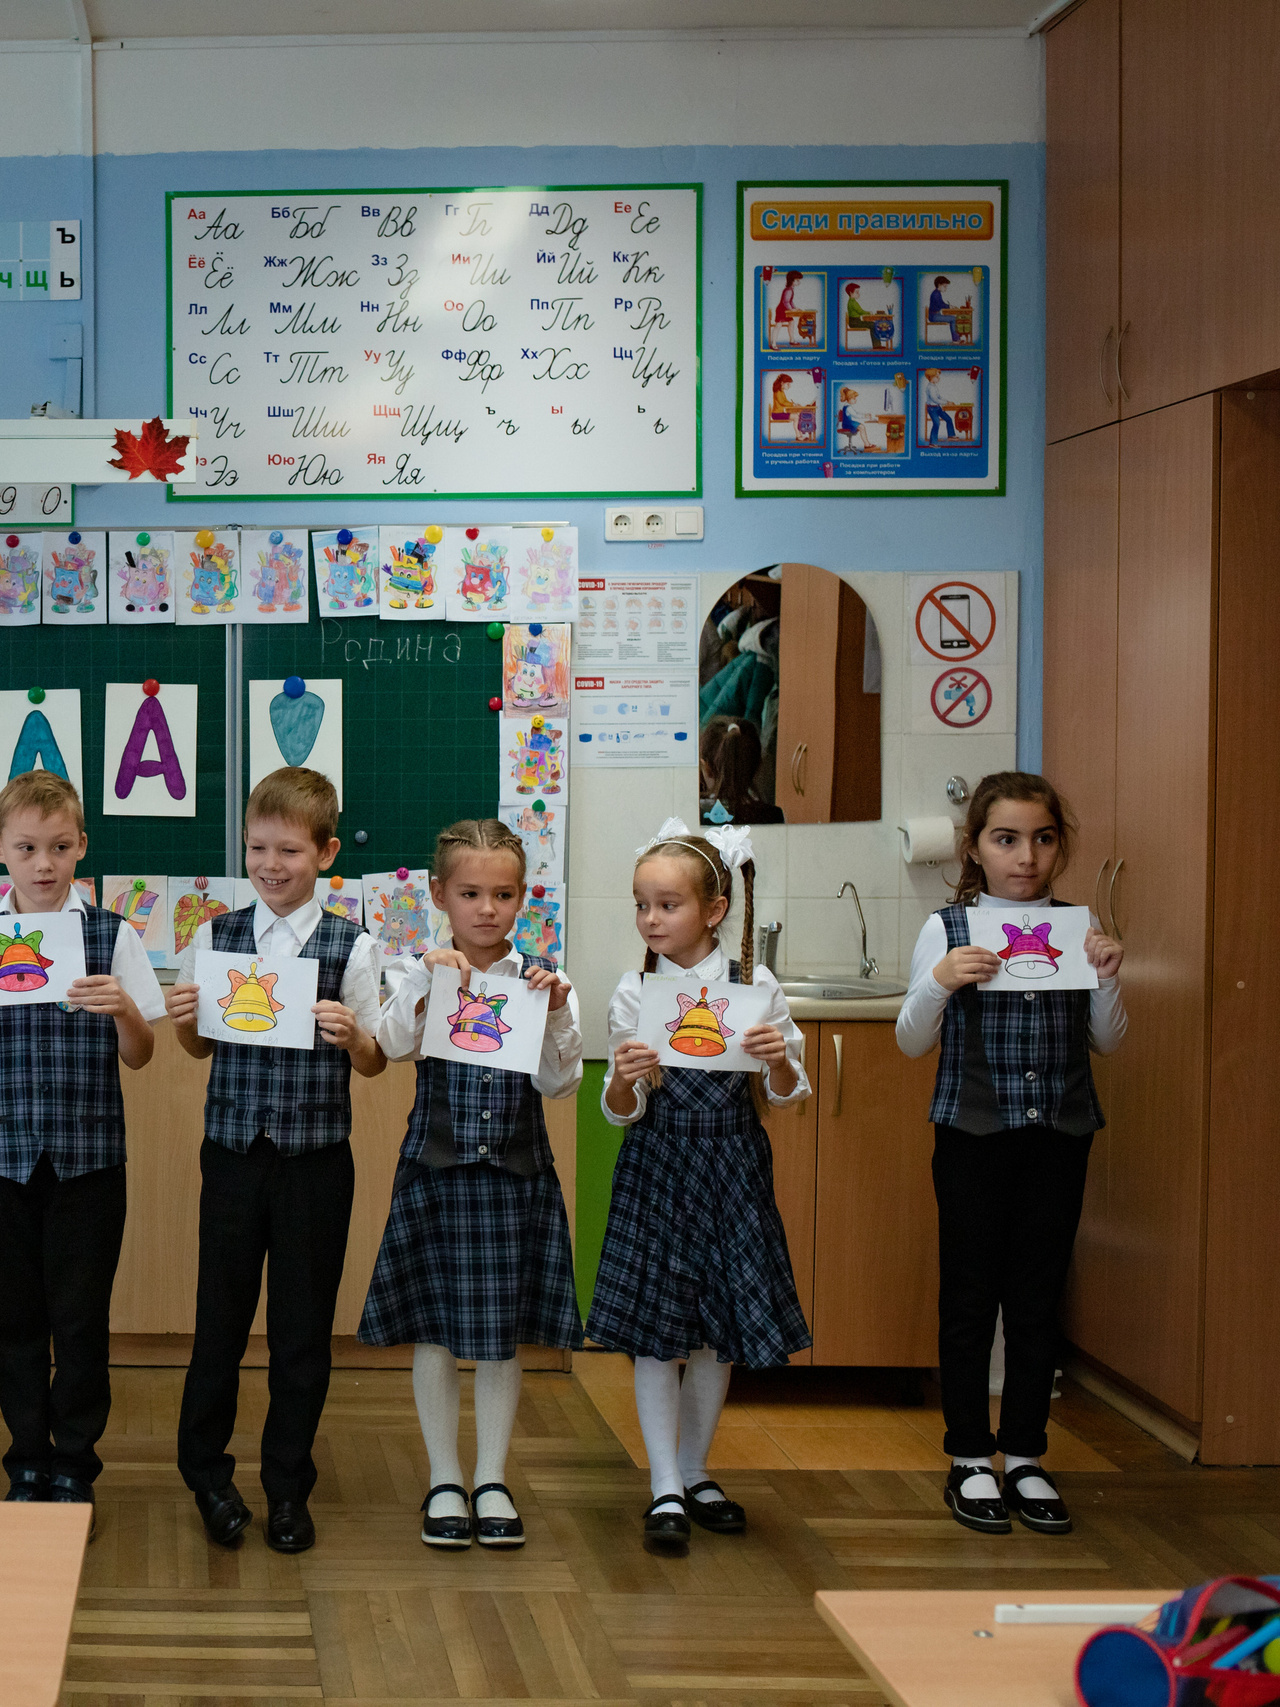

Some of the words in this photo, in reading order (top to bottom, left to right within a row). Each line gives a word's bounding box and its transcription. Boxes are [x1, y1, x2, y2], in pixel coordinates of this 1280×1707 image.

[187, 208, 206, 220] Аа
[271, 207, 290, 219] Бб
[361, 206, 381, 217] Вв
[445, 204, 460, 216] Гг
[529, 203, 550, 217] Дд
[614, 202, 632, 213] Ее
[760, 208, 829, 233] Сиди
[838, 212, 984, 235] правильно
[56, 227, 76, 244] ъ
[188, 255, 206, 269] Ёё
[263, 256, 288, 268] Жж
[371, 254, 388, 266] Зз
[451, 253, 470, 265] Ии
[536, 250, 556, 264] Йй
[613, 251, 629, 263] Кк
[26, 270, 48, 291] щ
[60, 271, 75, 288] ь
[188, 303, 208, 315] Лл
[269, 302, 292, 313] Мм
[360, 301, 380, 312] Нн
[443, 300, 464, 311] Оо
[530, 298, 549, 310] Пп
[614, 298, 633, 312] Рр
[188, 353, 207, 364] Сс
[263, 352, 280, 363] Тт
[364, 350, 381, 364] Уу
[441, 349, 467, 363] Фф
[521, 348, 538, 359] Хх
[613, 347, 633, 361] Цц
[767, 354, 794, 362] Посадка
[189, 407, 207, 418] Чч
[267, 406, 294, 417] Шш
[373, 405, 401, 418] Щщ
[268, 454, 295, 466] Юю
[367, 453, 386, 465] Яя
[761, 451, 788, 459] Посадка
[839, 461, 865, 469] Посадка
[41, 486, 62, 515] 0
[578, 581, 604, 589] COVID-19
[576, 680, 603, 688] COVID-19
